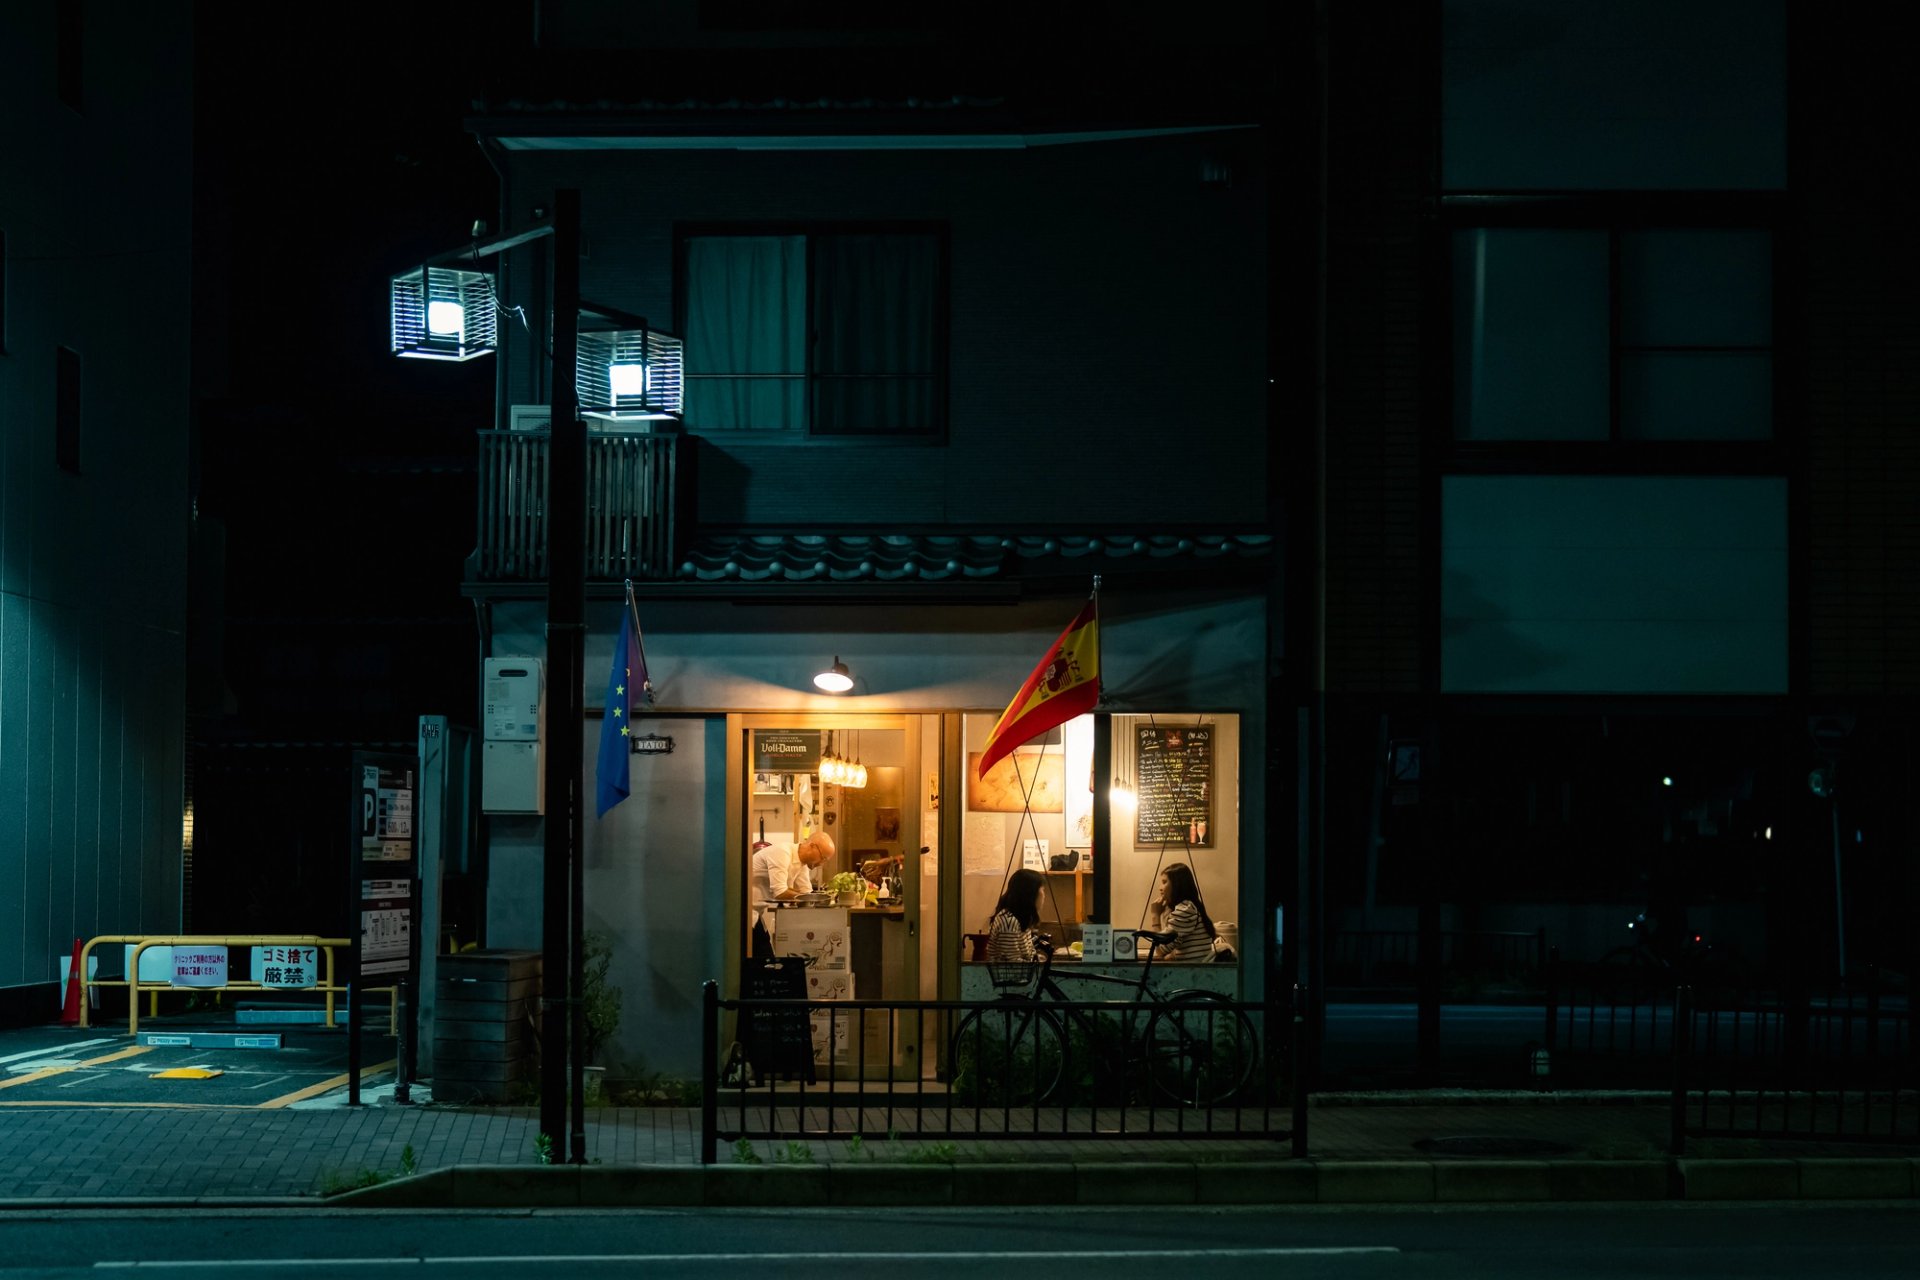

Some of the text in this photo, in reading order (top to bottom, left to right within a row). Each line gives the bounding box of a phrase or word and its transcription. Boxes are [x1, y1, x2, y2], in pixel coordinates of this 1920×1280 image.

[761, 743, 807, 753] Voll-Damm
[364, 793, 374, 831] P
[263, 948, 315, 964] ゴミ捨て
[264, 967, 304, 984] 厳禁
